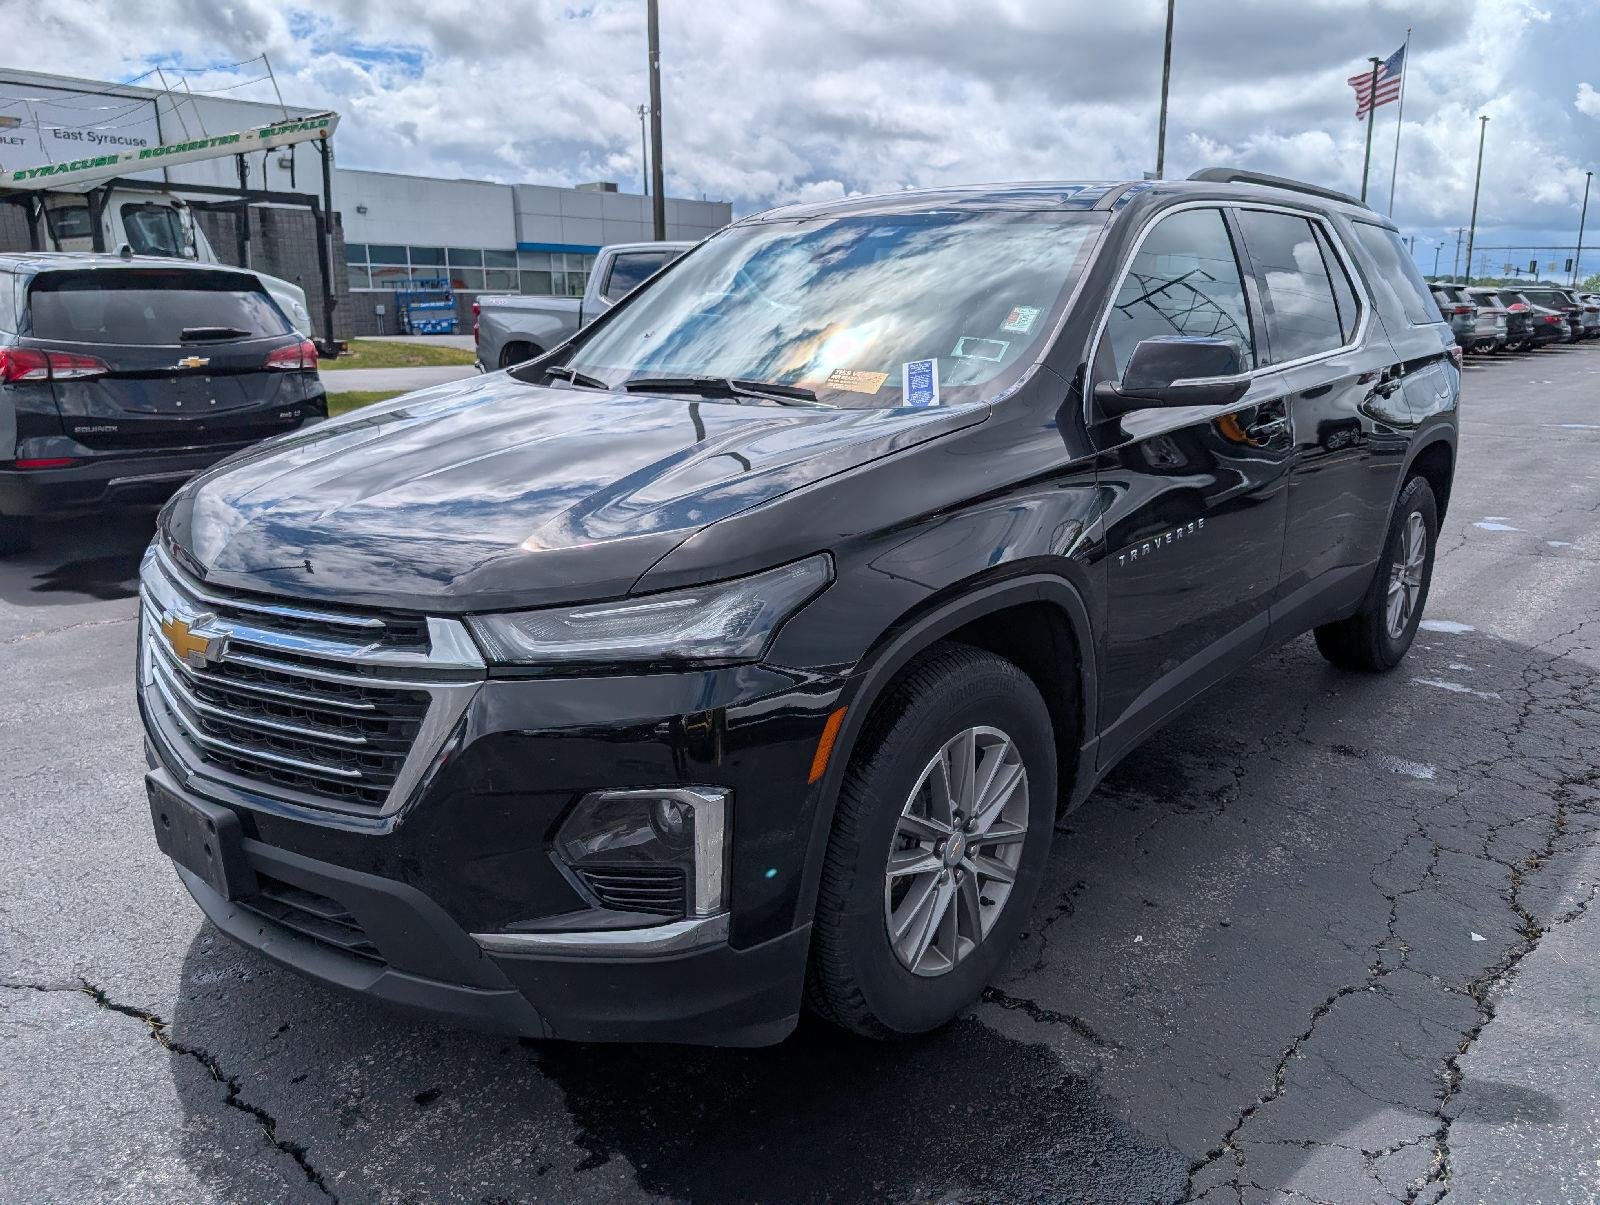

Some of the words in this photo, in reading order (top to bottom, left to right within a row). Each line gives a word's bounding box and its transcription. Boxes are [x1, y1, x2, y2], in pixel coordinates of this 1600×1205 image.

[13, 155, 119, 181] SYRACUSE
[138, 133, 241, 159] ROCHESTER
[258, 118, 330, 139] BUFFALO
[53, 128, 83, 141] East
[87, 131, 147, 147] Syracuse
[1118, 517, 1205, 567] TRAVERSE
